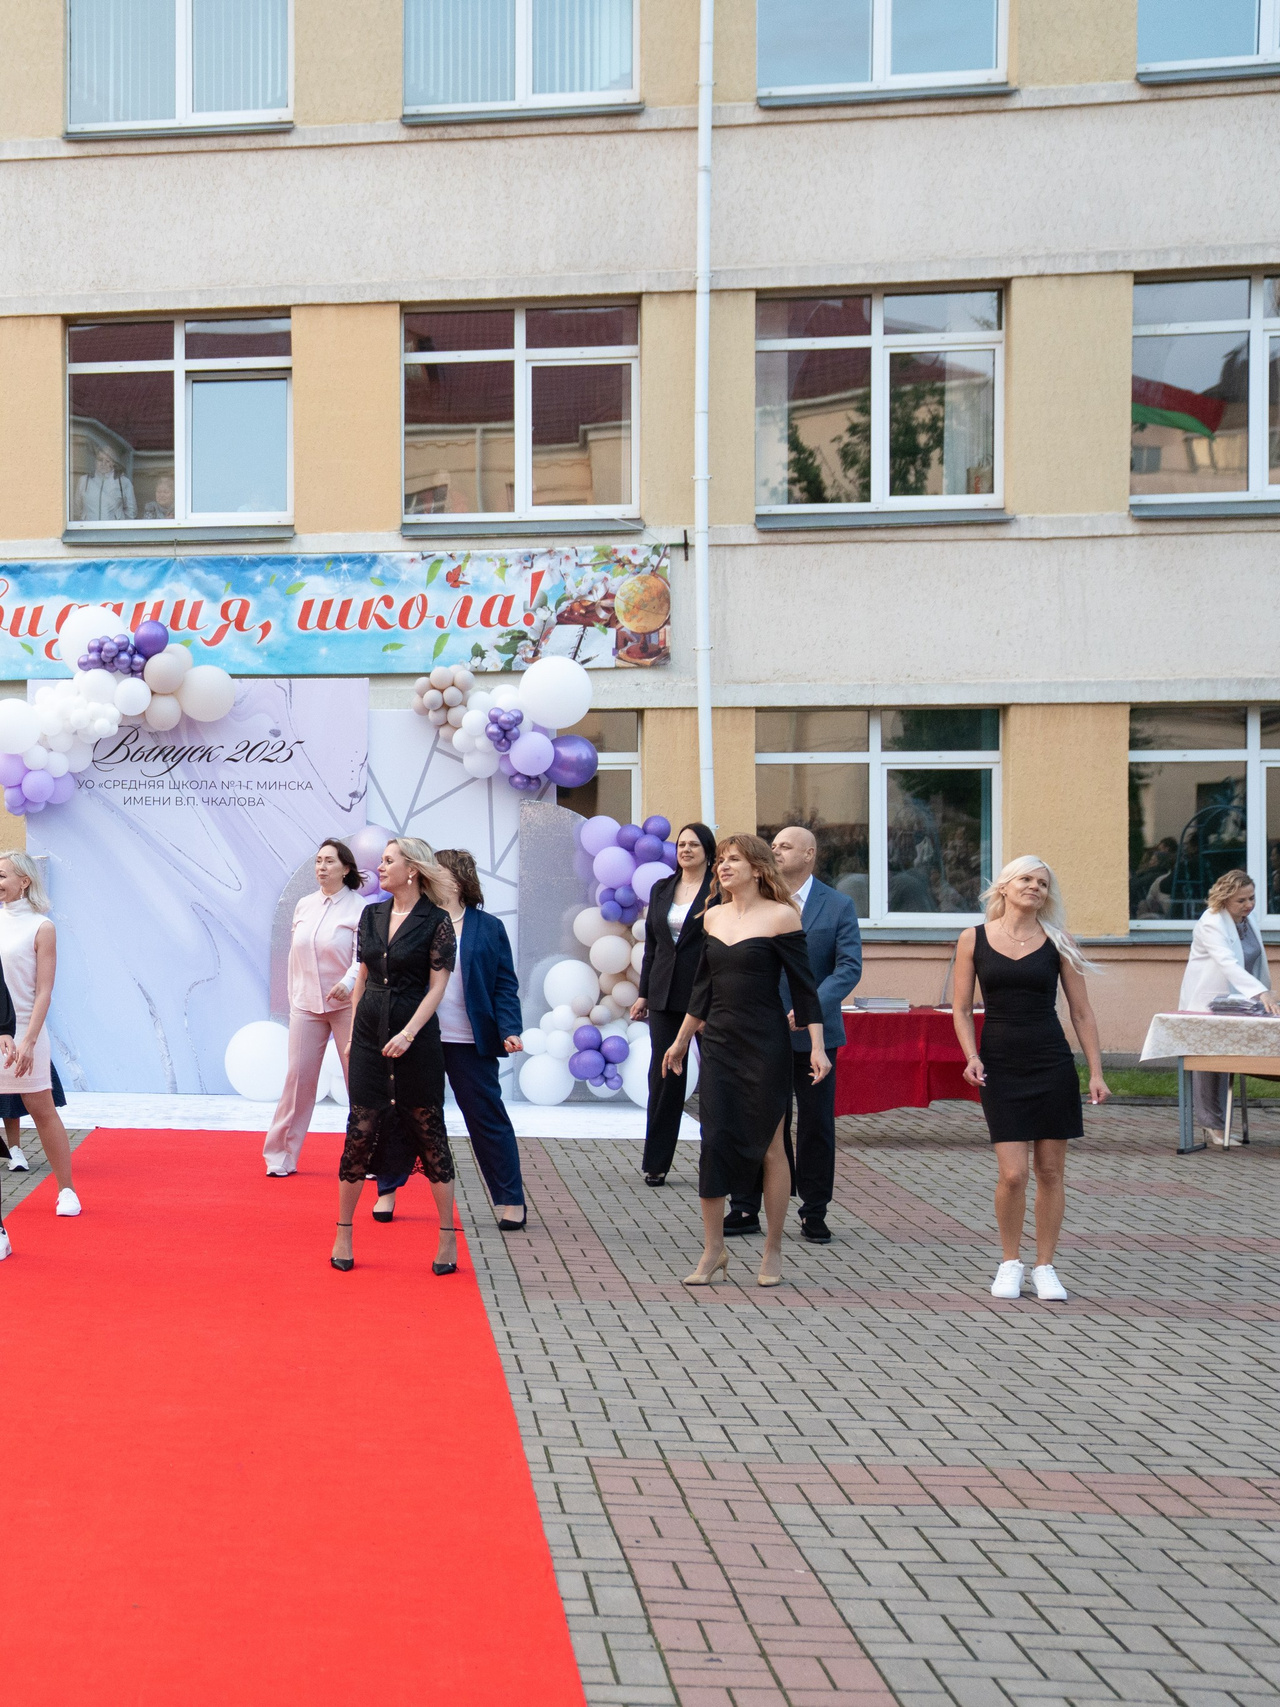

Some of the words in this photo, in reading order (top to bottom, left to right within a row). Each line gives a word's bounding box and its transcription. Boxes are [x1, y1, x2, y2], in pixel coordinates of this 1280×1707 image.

[297, 570, 546, 631] школа!
[92, 725, 224, 778] Выпуск
[224, 740, 305, 764] 2025
[77, 779, 96, 790] УО
[98, 779, 165, 791] «СРЕДНЯЯ
[168, 780, 218, 790] ШКОЛА
[256, 780, 314, 791] МИНСКА
[123, 796, 171, 806] ИМЕНИ
[175, 796, 199, 807] В.П.
[201, 796, 266, 807] ЧКАЛОВА
